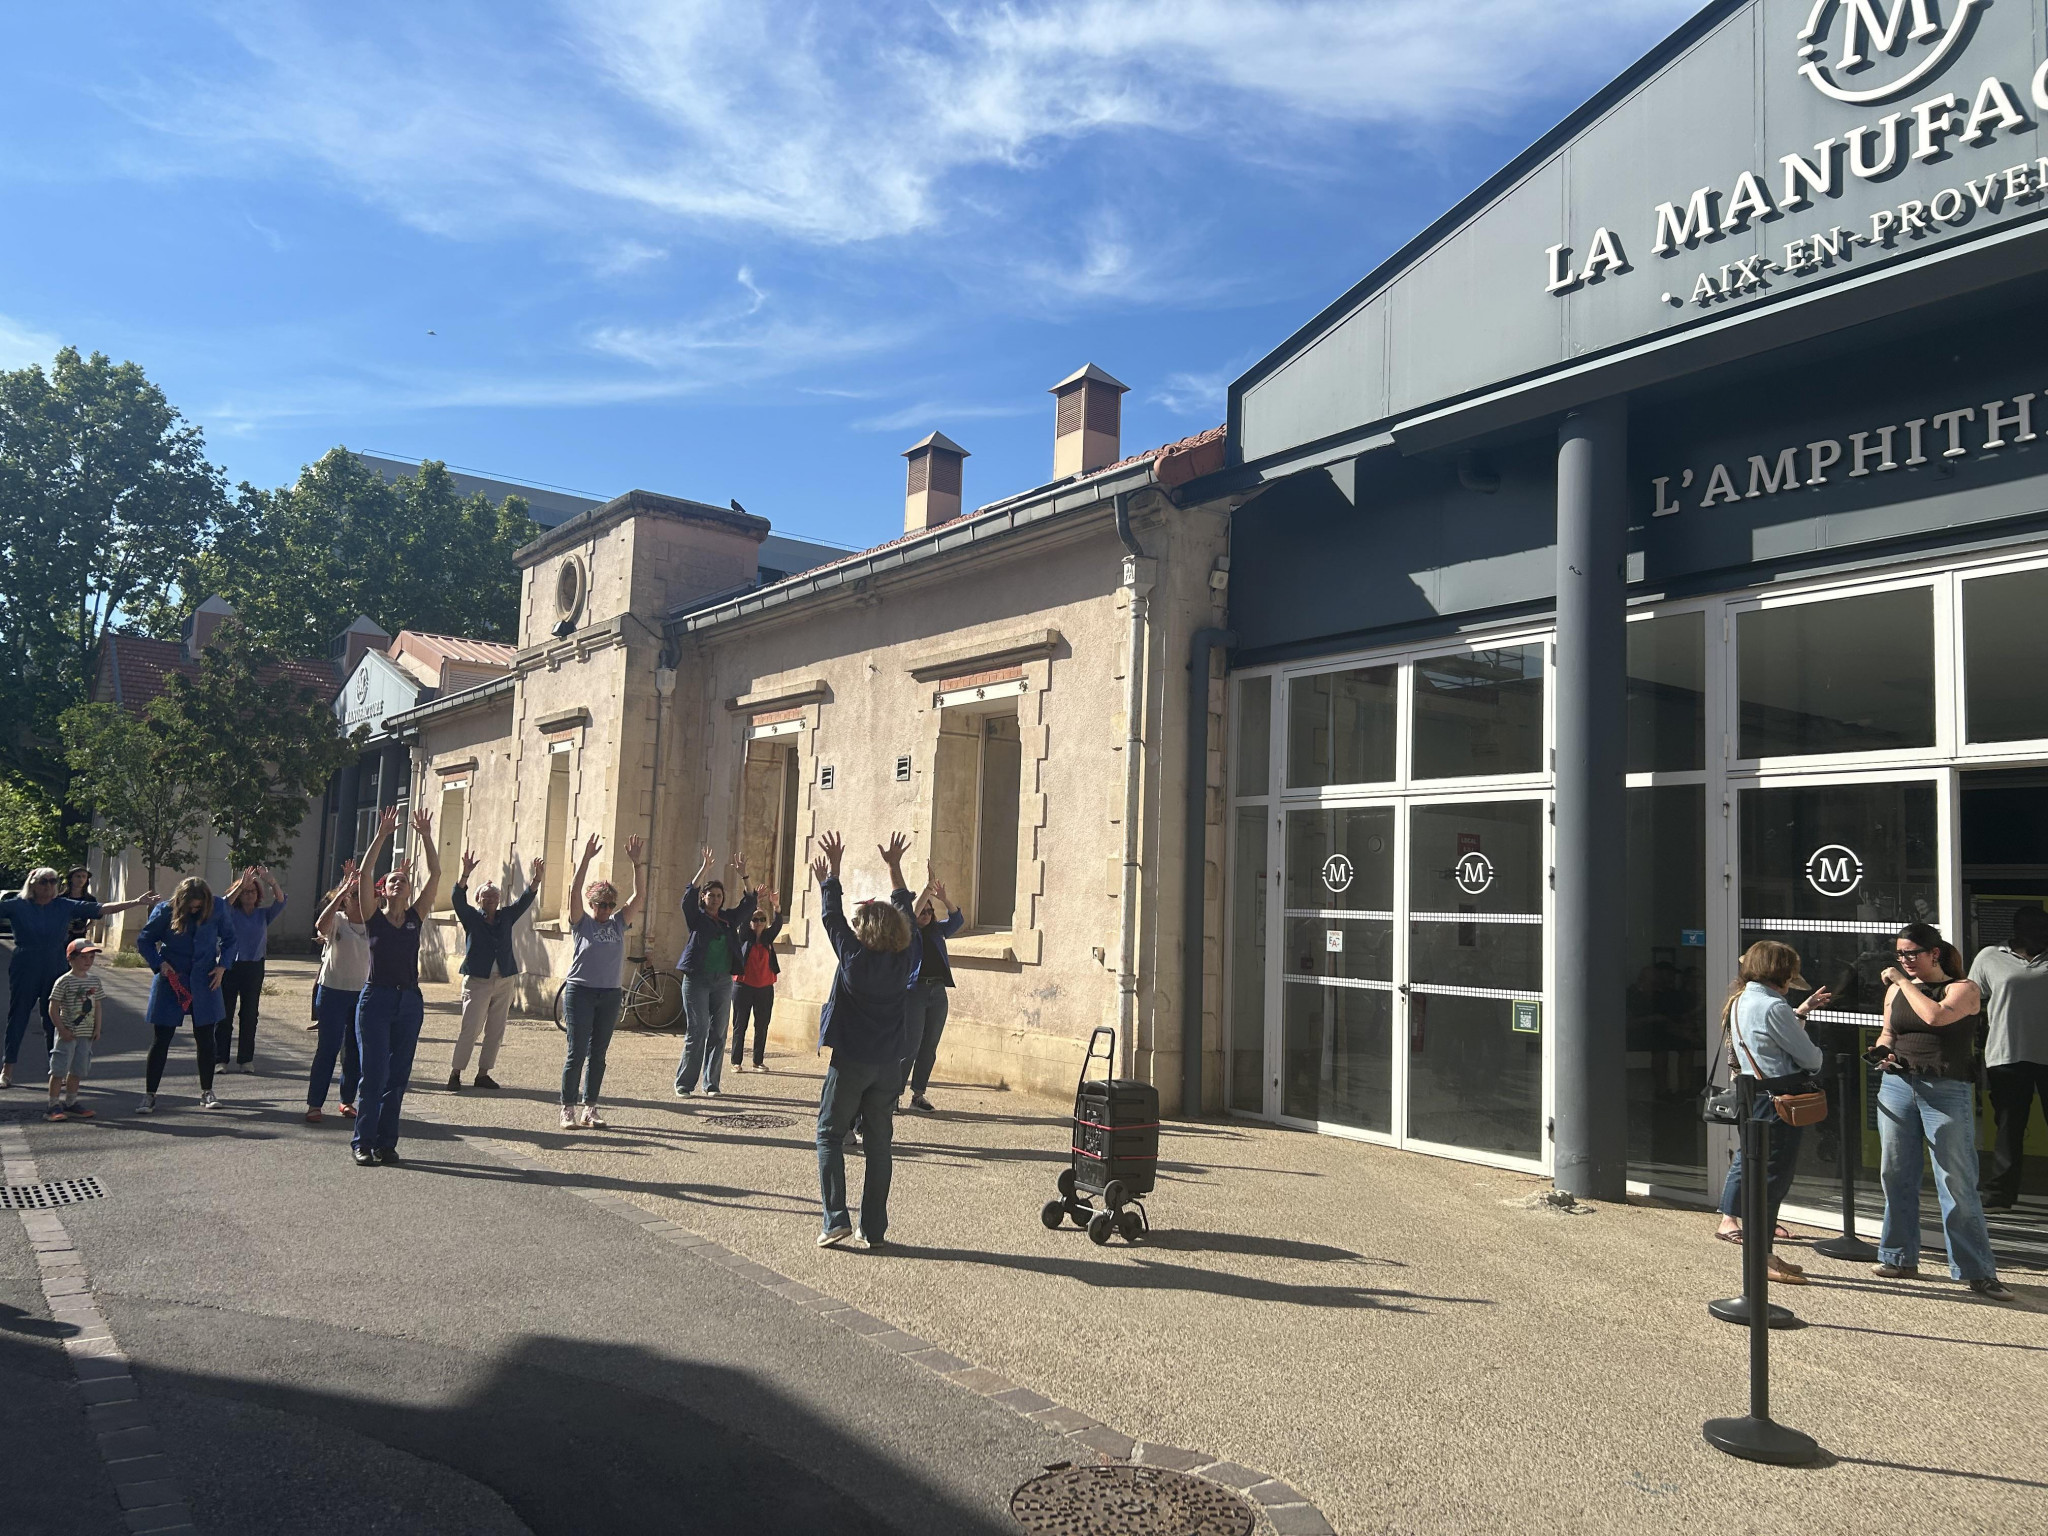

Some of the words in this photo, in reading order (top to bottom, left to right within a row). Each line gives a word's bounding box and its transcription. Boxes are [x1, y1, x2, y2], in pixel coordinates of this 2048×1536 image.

[1836, 0, 1937, 69] M
[1544, 226, 1624, 293] LA
[1651, 388, 2048, 517] L'AMPHITH
[1328, 863, 1347, 882] M
[1463, 862, 1485, 883] M
[1818, 857, 1850, 882] M
